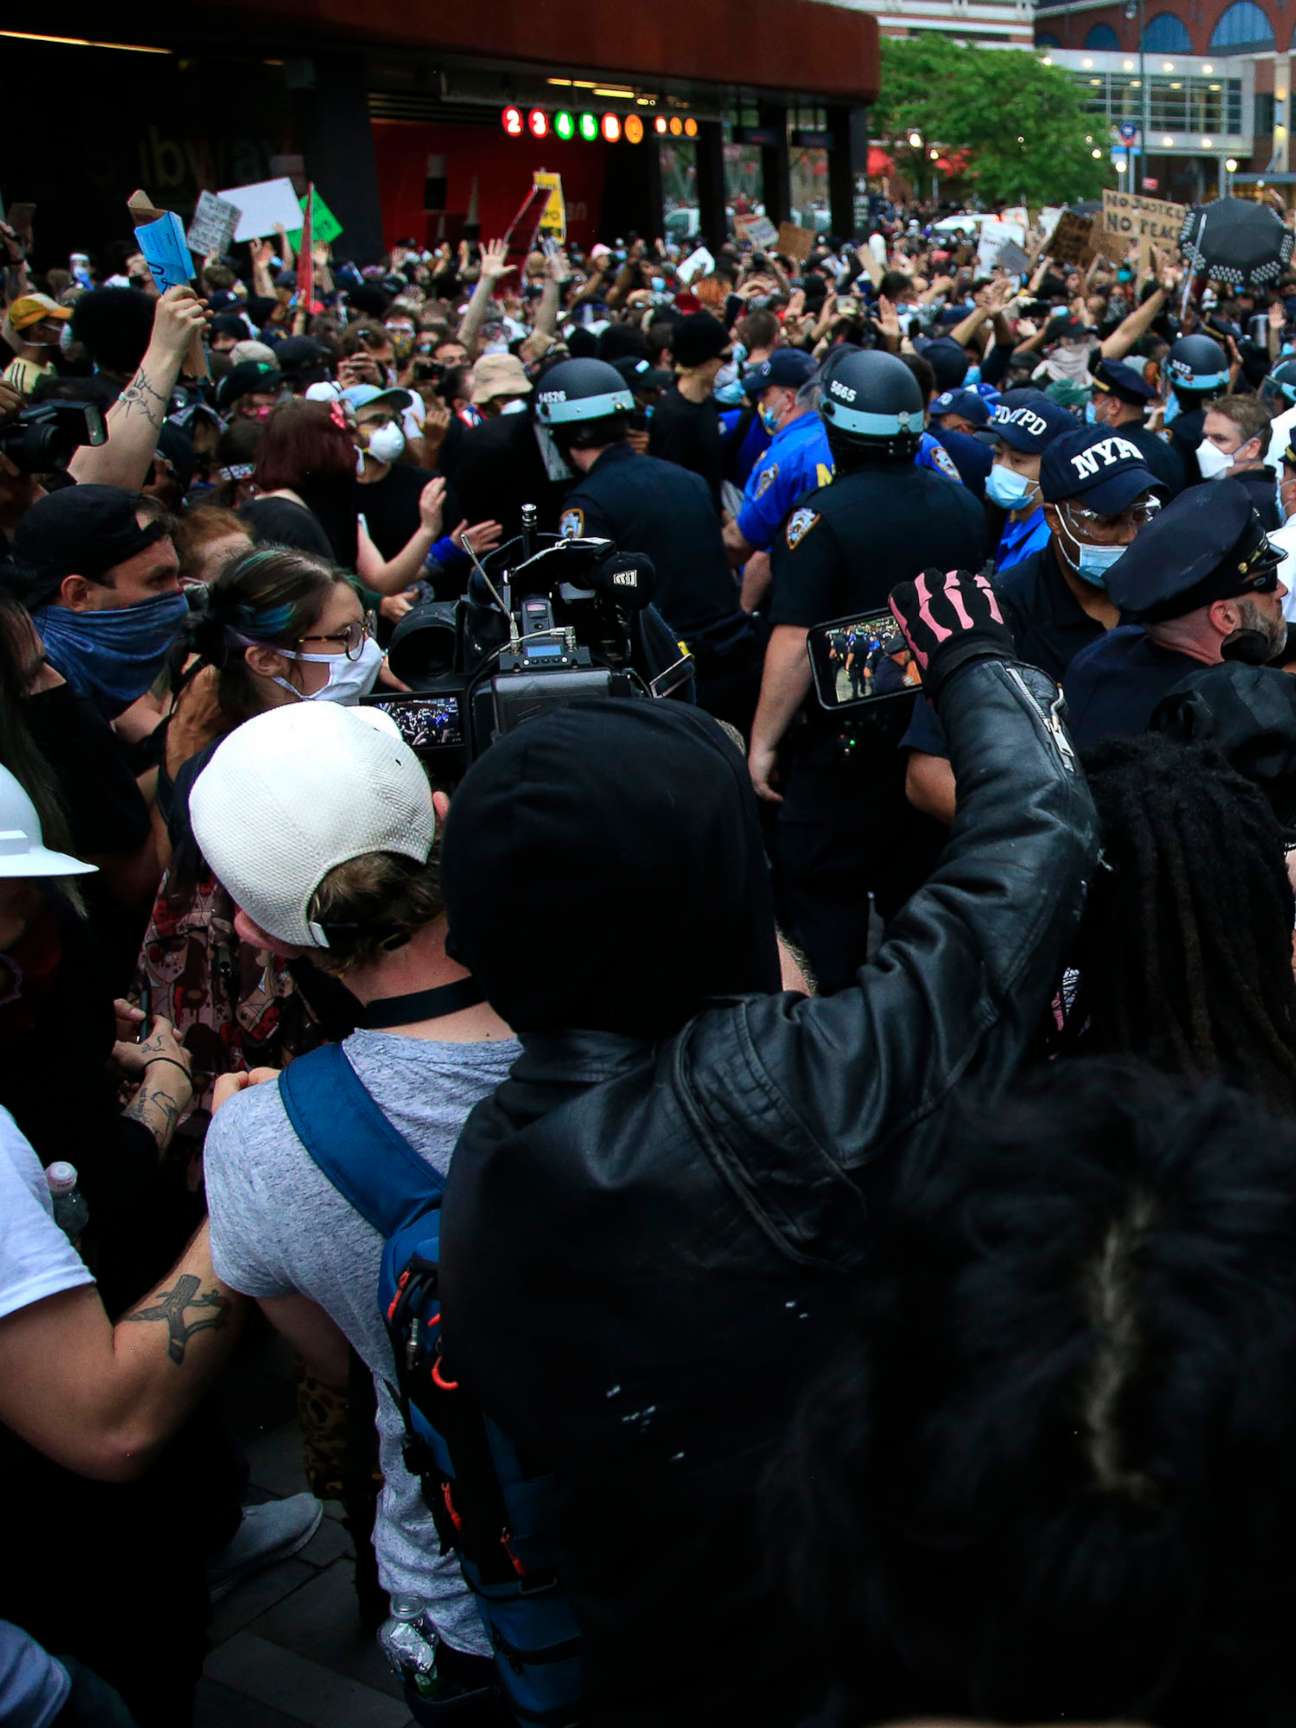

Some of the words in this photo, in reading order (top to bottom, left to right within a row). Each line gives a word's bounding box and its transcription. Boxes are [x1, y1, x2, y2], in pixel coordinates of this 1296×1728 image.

[505, 108, 522, 133] 2
[532, 110, 548, 135] 3
[558, 112, 572, 135] 4
[1107, 212, 1132, 232] NO
